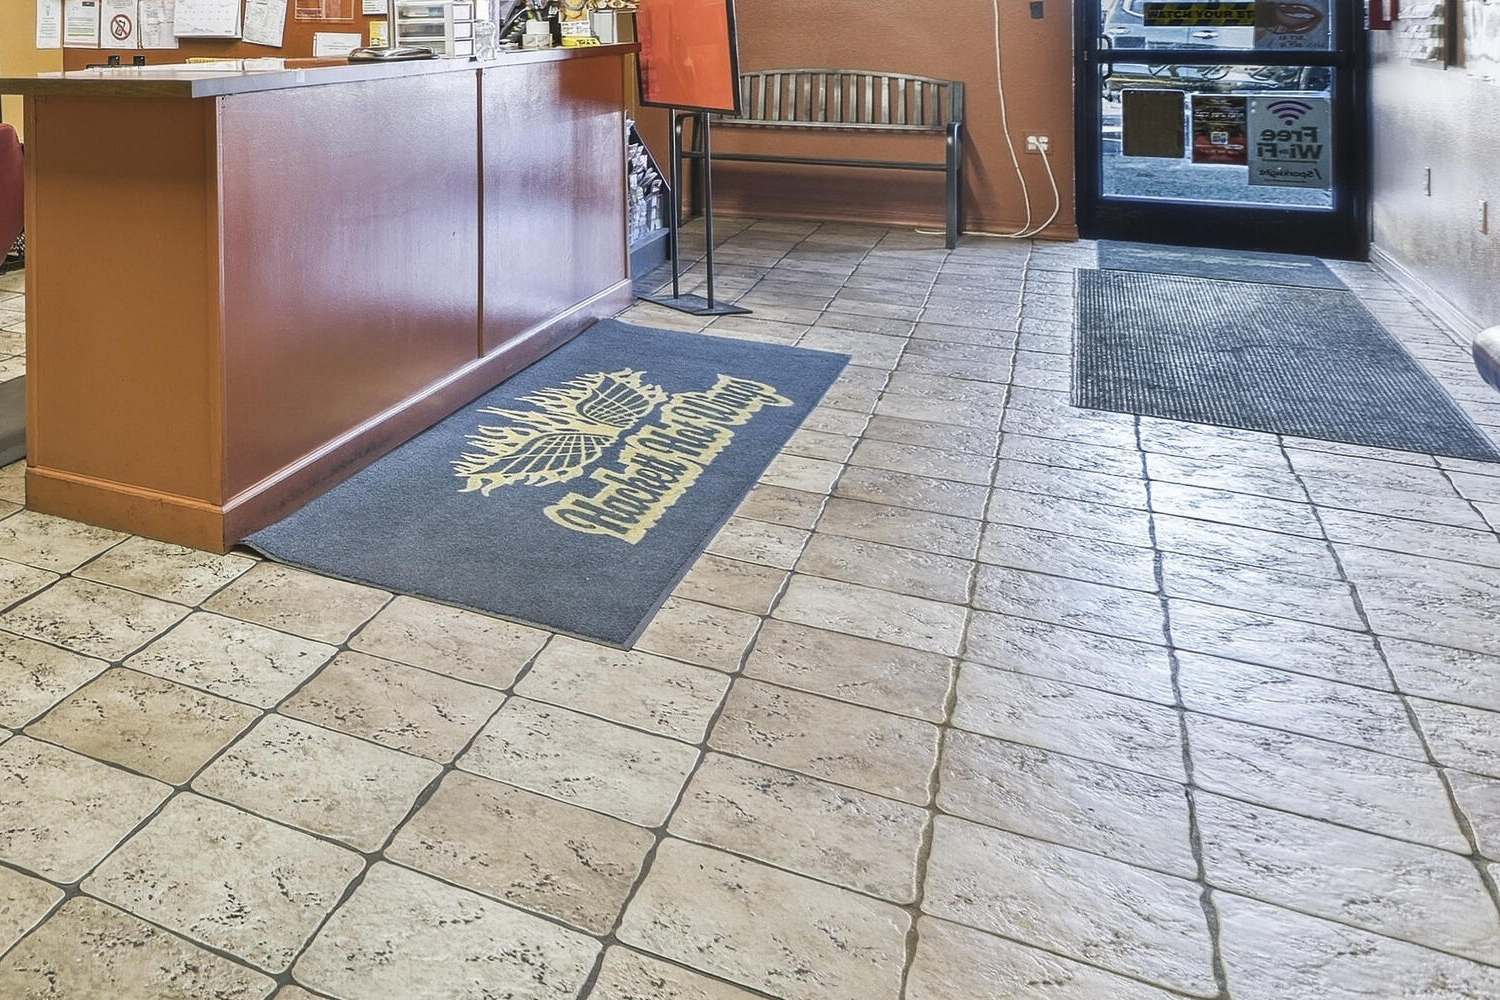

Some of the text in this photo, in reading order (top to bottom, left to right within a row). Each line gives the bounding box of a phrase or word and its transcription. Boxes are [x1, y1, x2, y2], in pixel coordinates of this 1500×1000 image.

[1148, 10, 1191, 19] WATCH
[1195, 10, 1233, 19] YOUR
[556, 380, 780, 534] Hackett Hot Wings
